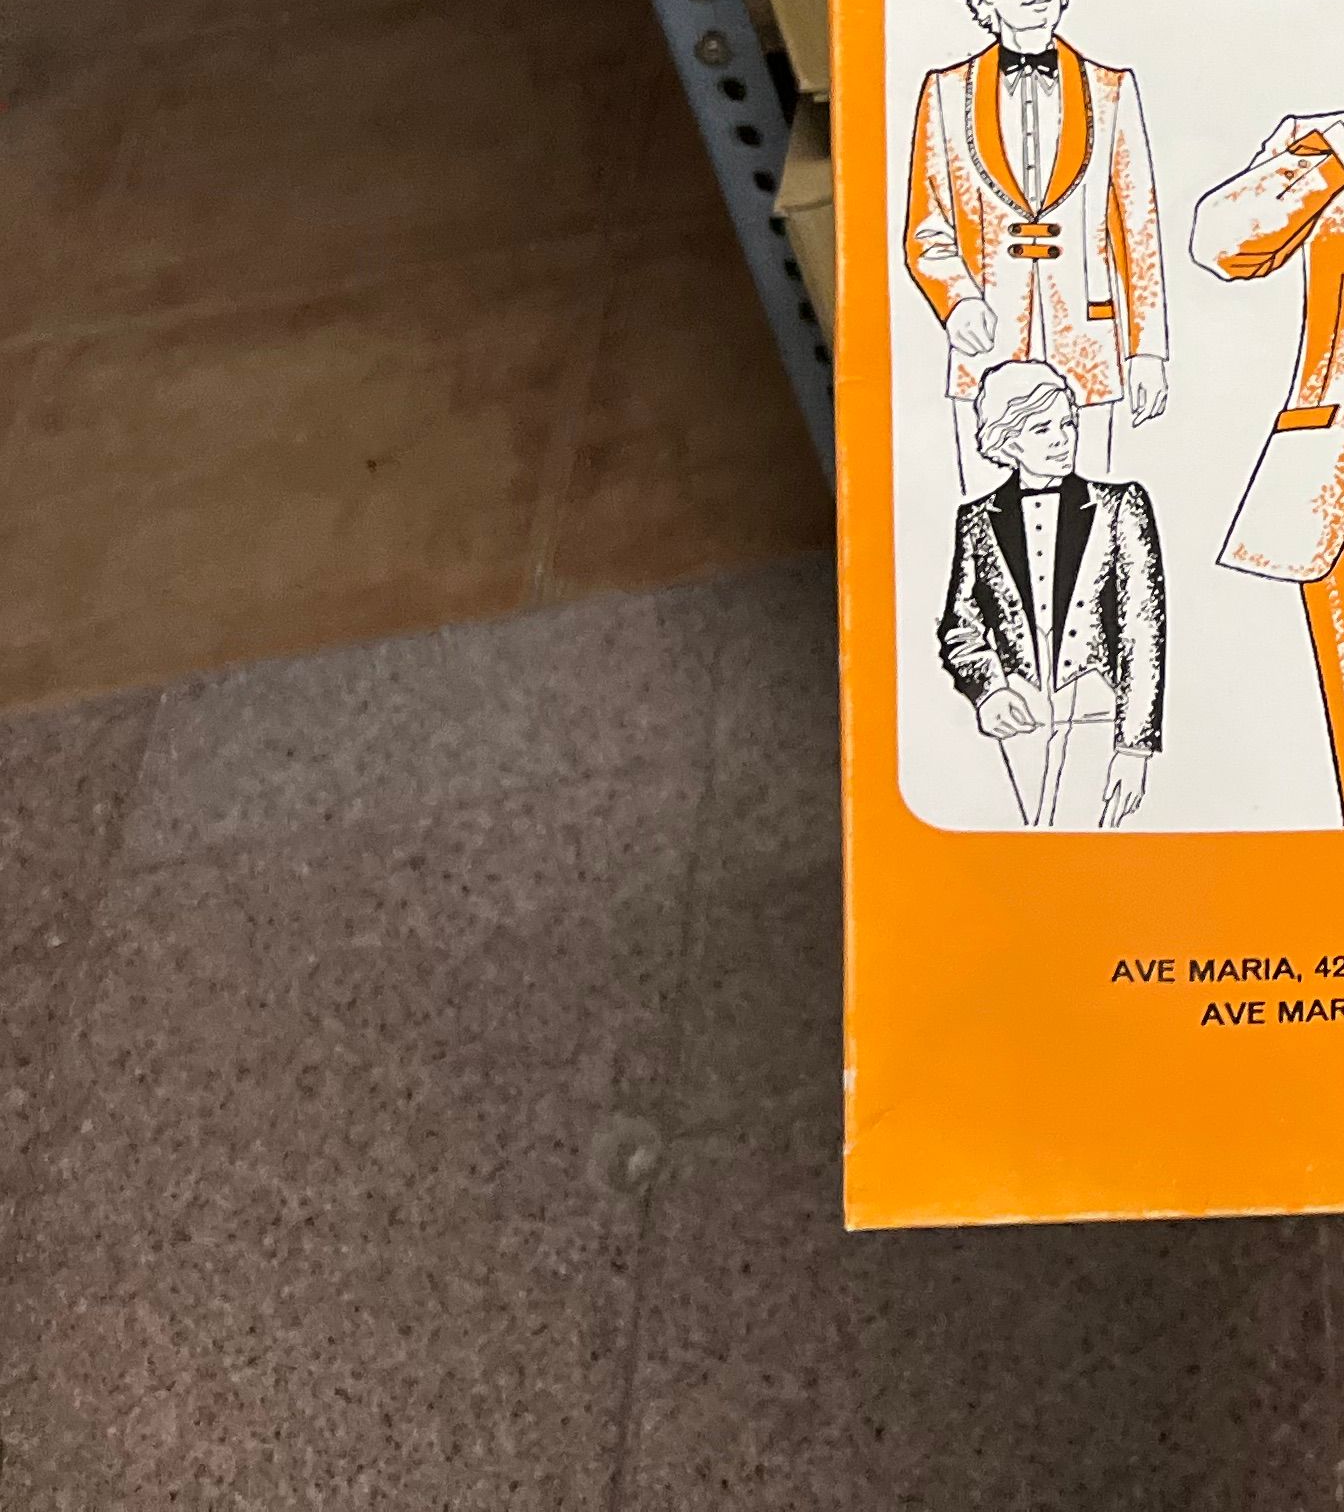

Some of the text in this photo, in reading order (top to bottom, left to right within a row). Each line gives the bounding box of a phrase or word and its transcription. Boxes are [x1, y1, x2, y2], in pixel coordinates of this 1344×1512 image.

[1111, 959, 1176, 983] AVE
[1189, 956, 1302, 983] MARIA,
[1200, 1001, 1266, 1027] AVE
